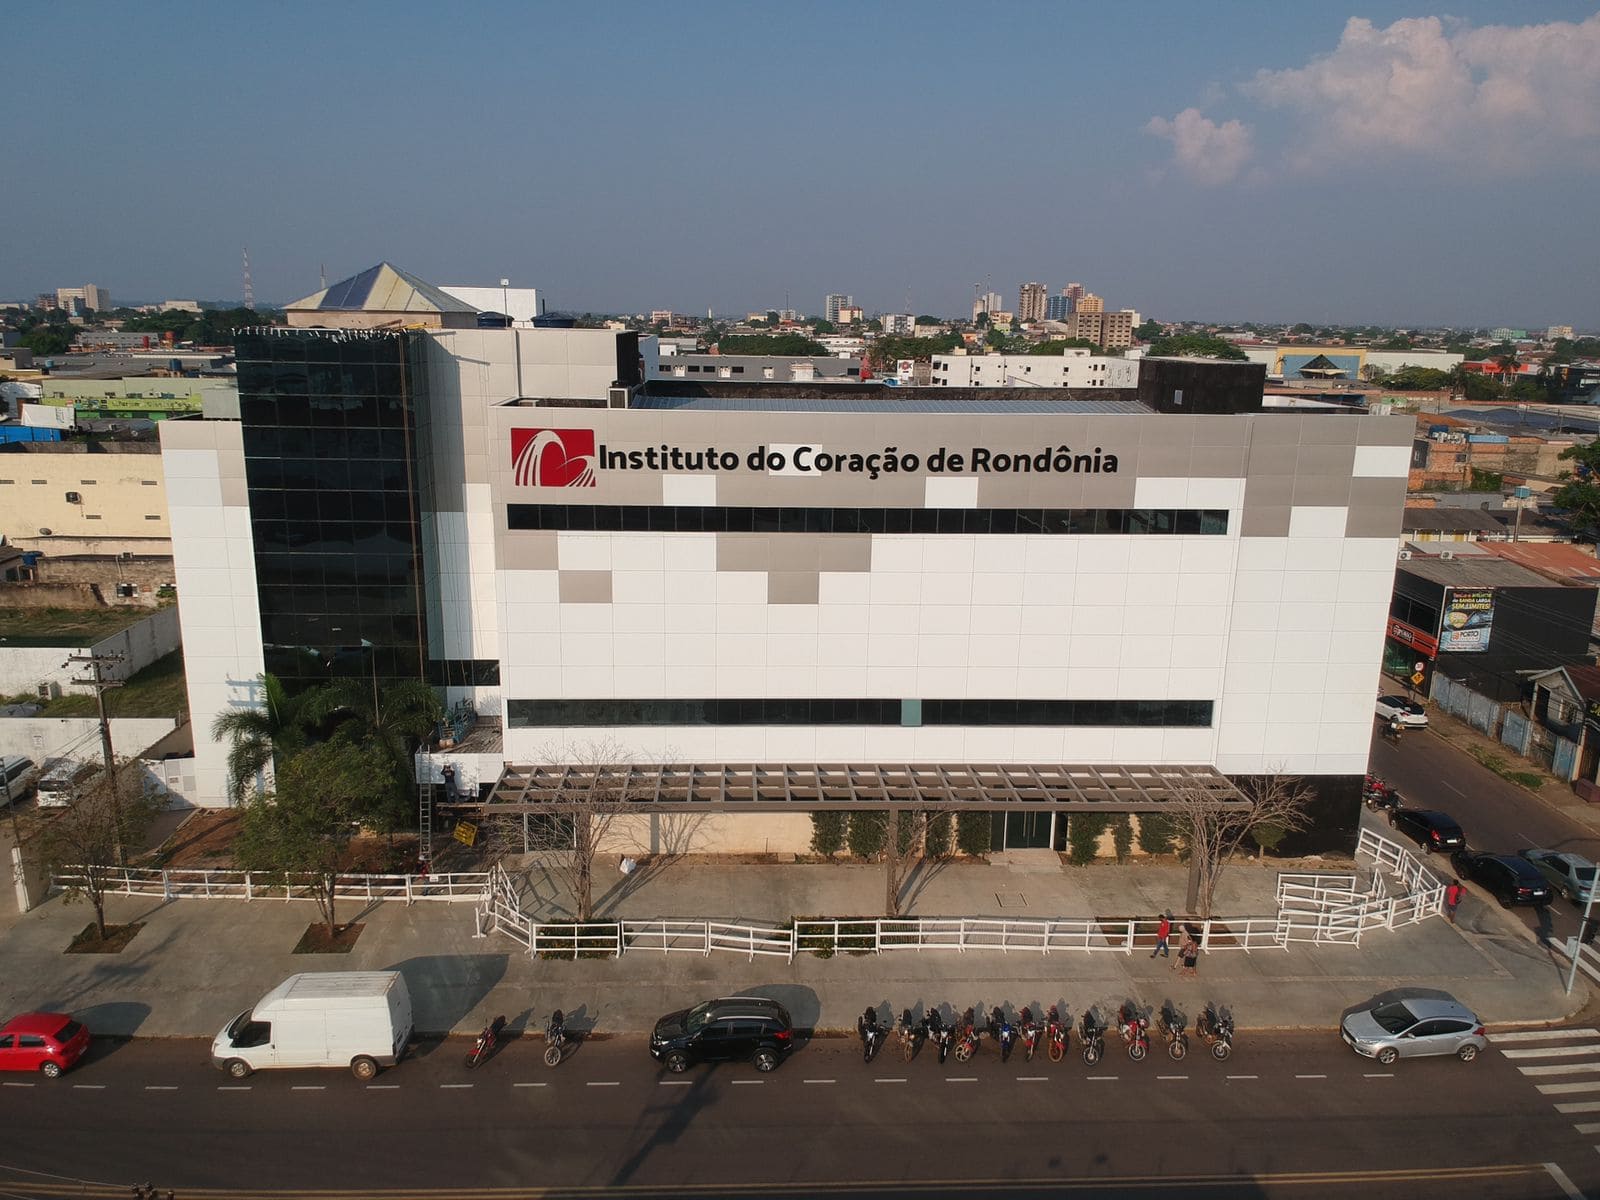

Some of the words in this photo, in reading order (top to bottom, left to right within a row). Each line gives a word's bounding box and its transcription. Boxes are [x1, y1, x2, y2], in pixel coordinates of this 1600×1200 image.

[599, 444, 740, 470] Instituto
[747, 445, 786, 471] do
[793, 446, 920, 480] Coração
[926, 447, 964, 473] de
[971, 445, 1119, 473] Rondônia
